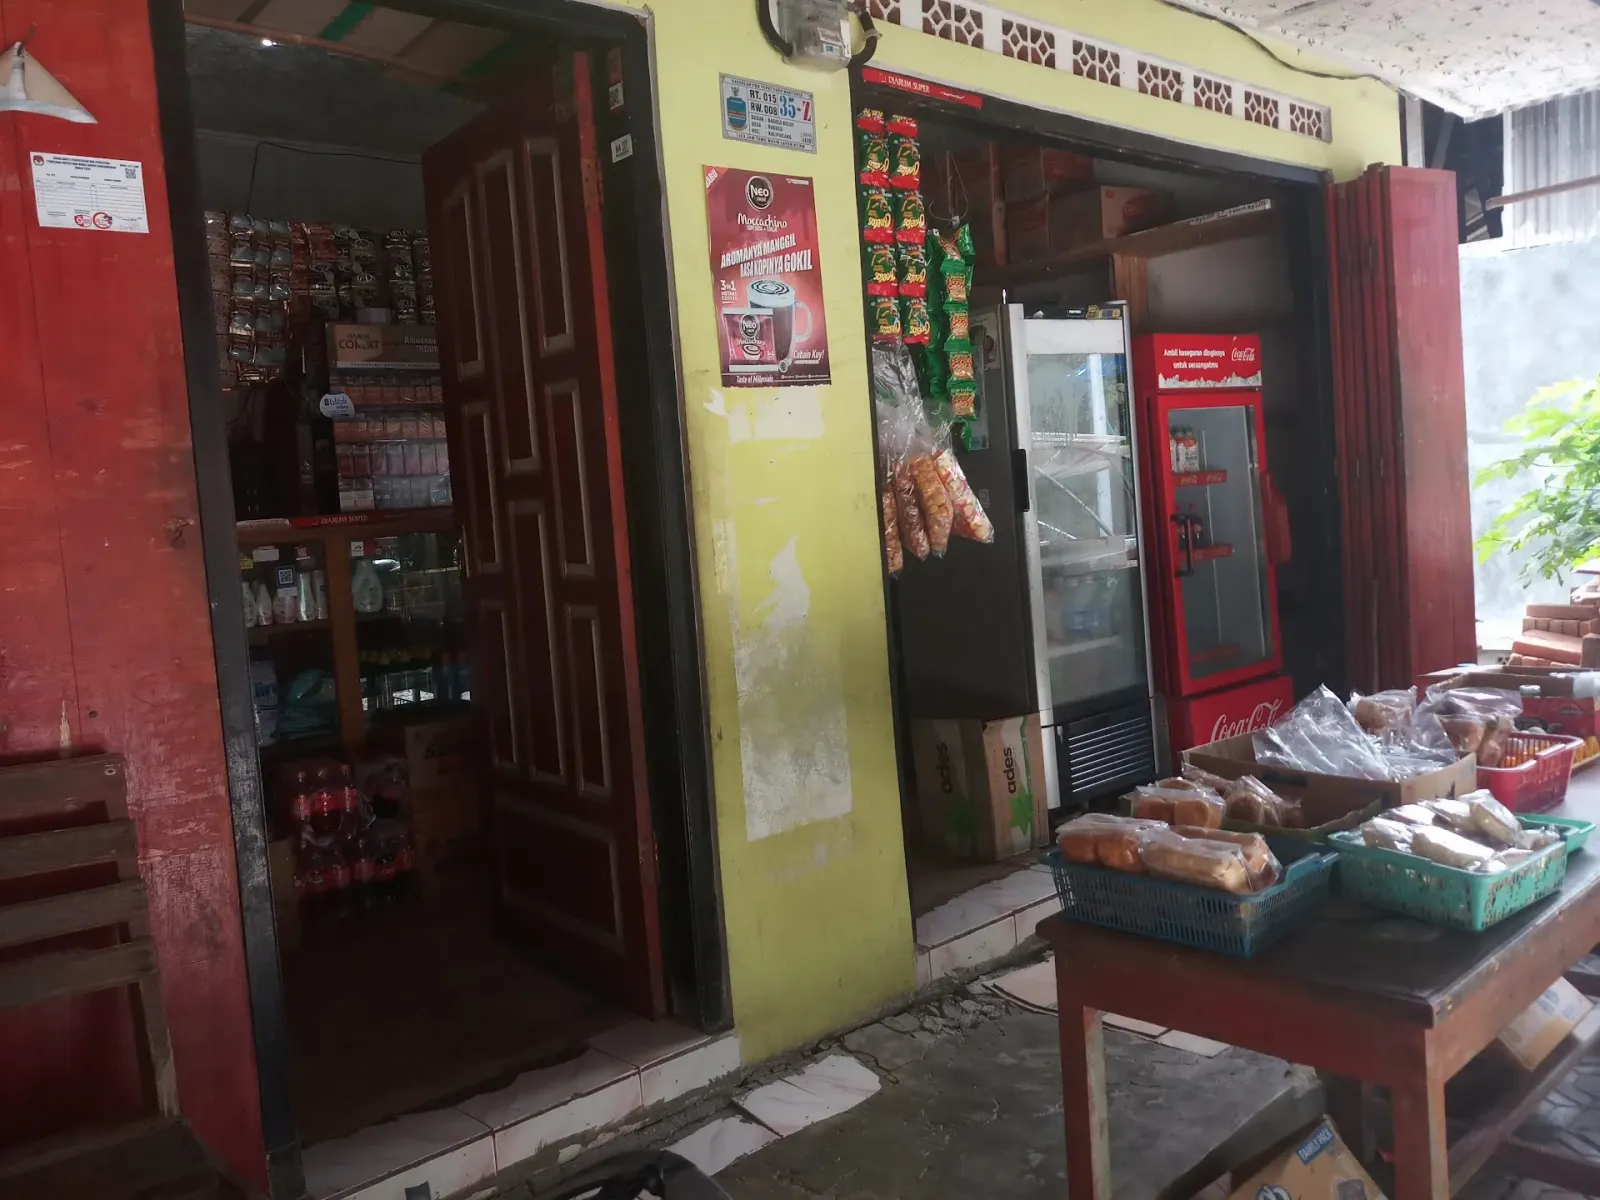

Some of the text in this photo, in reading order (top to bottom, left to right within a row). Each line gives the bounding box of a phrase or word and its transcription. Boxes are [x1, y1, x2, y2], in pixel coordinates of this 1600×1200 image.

[749, 89, 777, 104] RT. 015
[750, 101, 778, 116] RW. 008
[737, 212, 787, 229] Moccachino
[721, 233, 797, 269] AROMANYA MANGGIL
[740, 248, 813, 278] RASA KOPINYA GOKIL
[1163, 348, 1178, 357] Ambil
[1173, 361, 1188, 369] untuk
[1003, 744, 1017, 795] ades
[1297, 1126, 1334, 1161] FAMILY PACK
